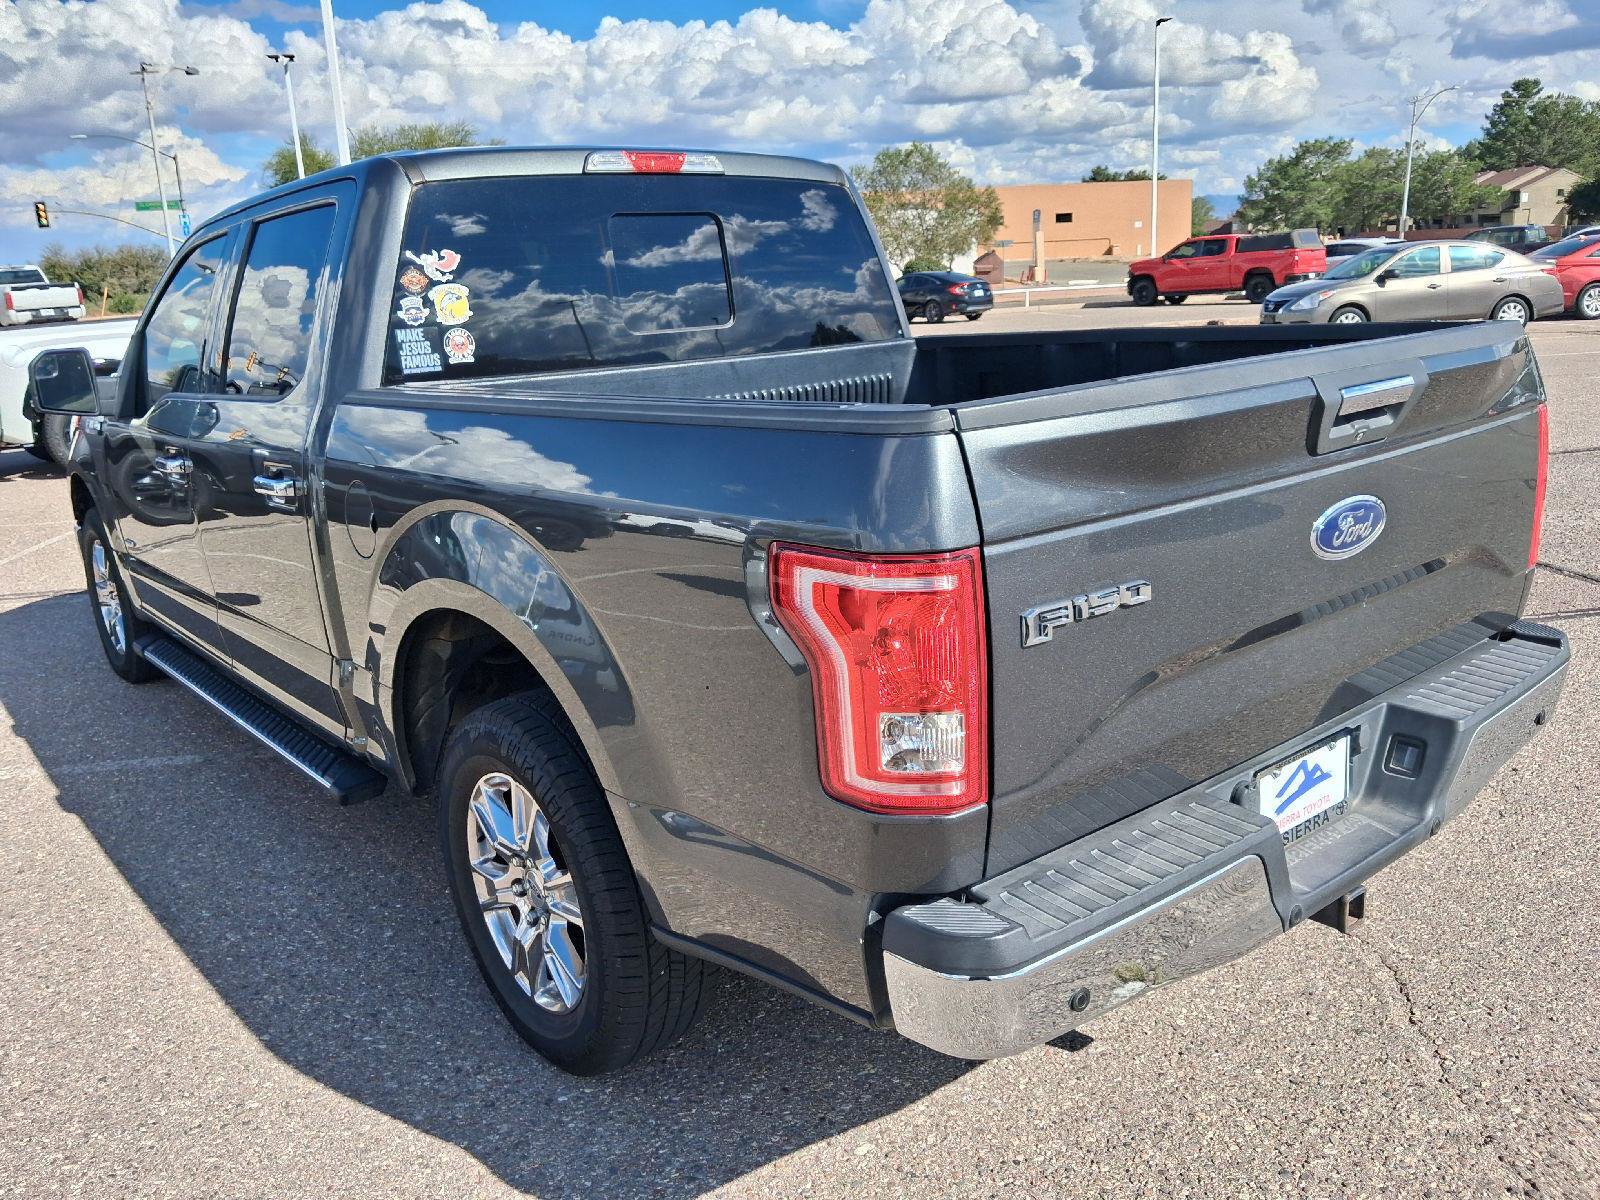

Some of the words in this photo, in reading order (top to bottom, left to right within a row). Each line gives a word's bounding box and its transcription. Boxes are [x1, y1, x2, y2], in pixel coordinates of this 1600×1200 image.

[395, 328, 425, 342] MAKE
[400, 341, 431, 355] JESUS
[401, 353, 441, 368] FAMOUS
[1332, 508, 1374, 548] Ford
[1303, 794, 1330, 816] TOYOTA
[1282, 809, 1329, 846] SIERRA
